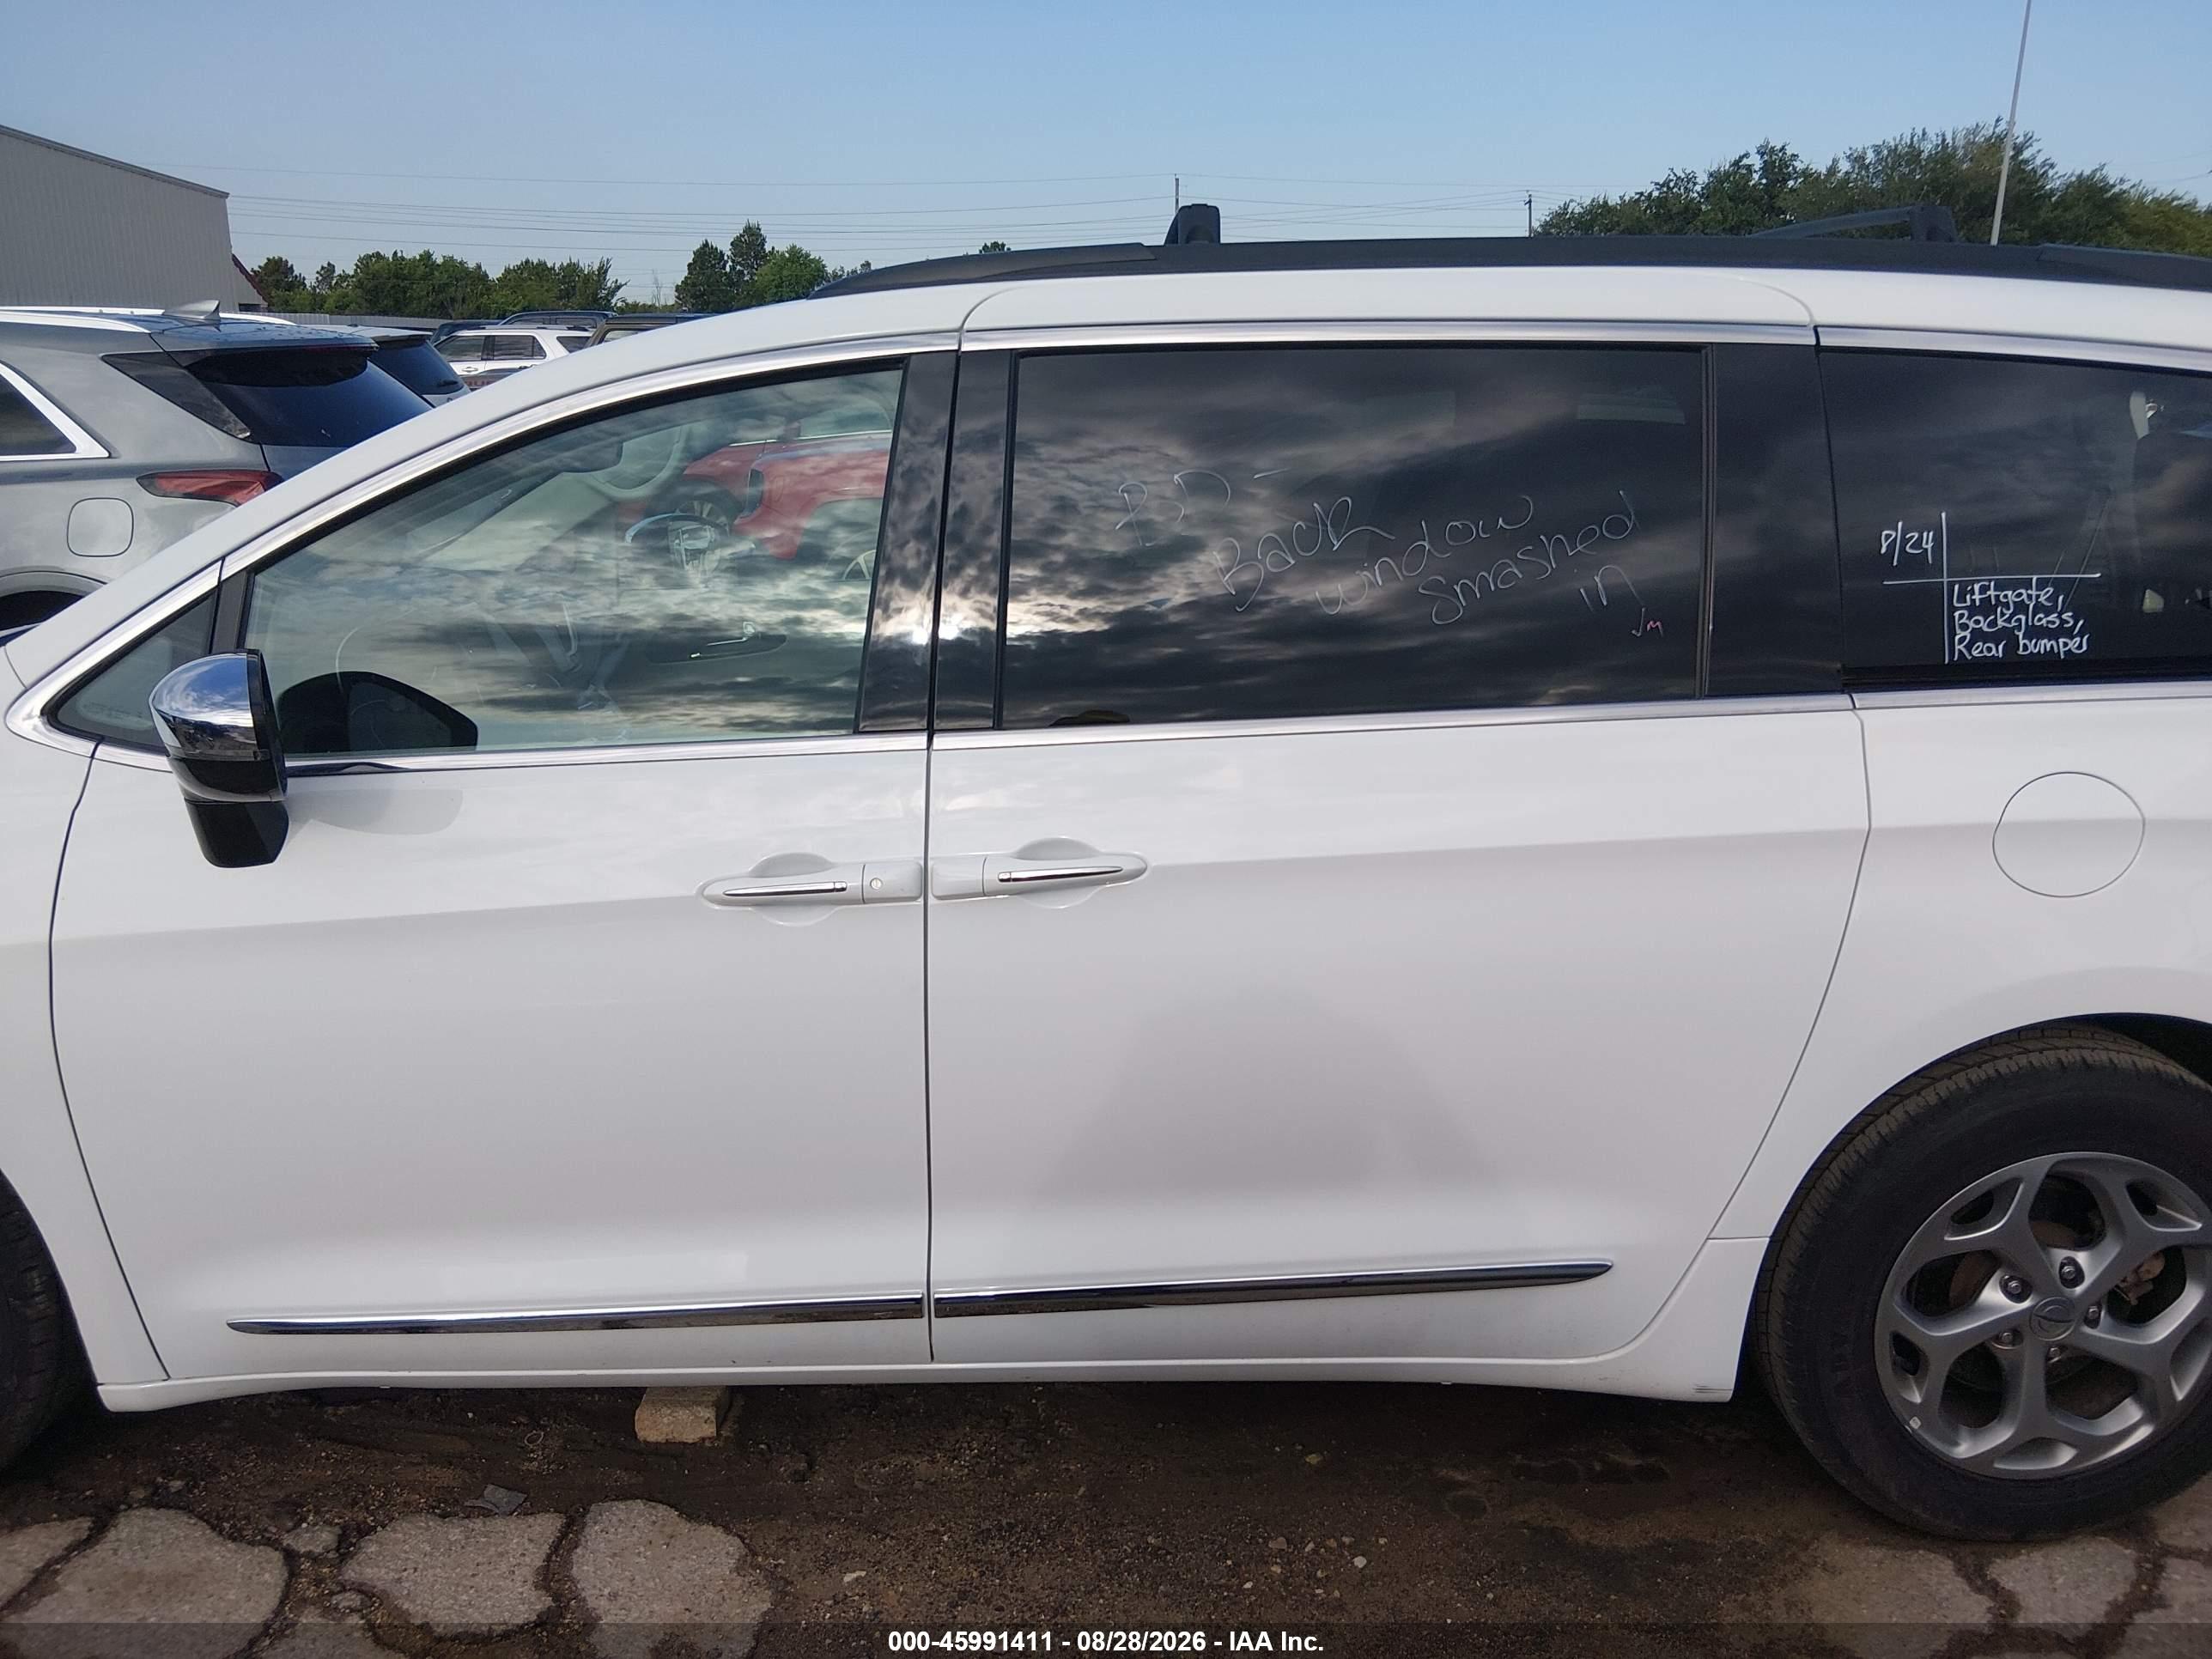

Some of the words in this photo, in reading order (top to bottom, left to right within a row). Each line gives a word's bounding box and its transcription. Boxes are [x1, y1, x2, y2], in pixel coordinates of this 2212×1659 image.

[1880, 520, 1935, 567] 8/24
[1952, 576, 2064, 613] Liftgate,
[1953, 631, 2007, 661] Rear
[2017, 633, 2090, 659] bumper
